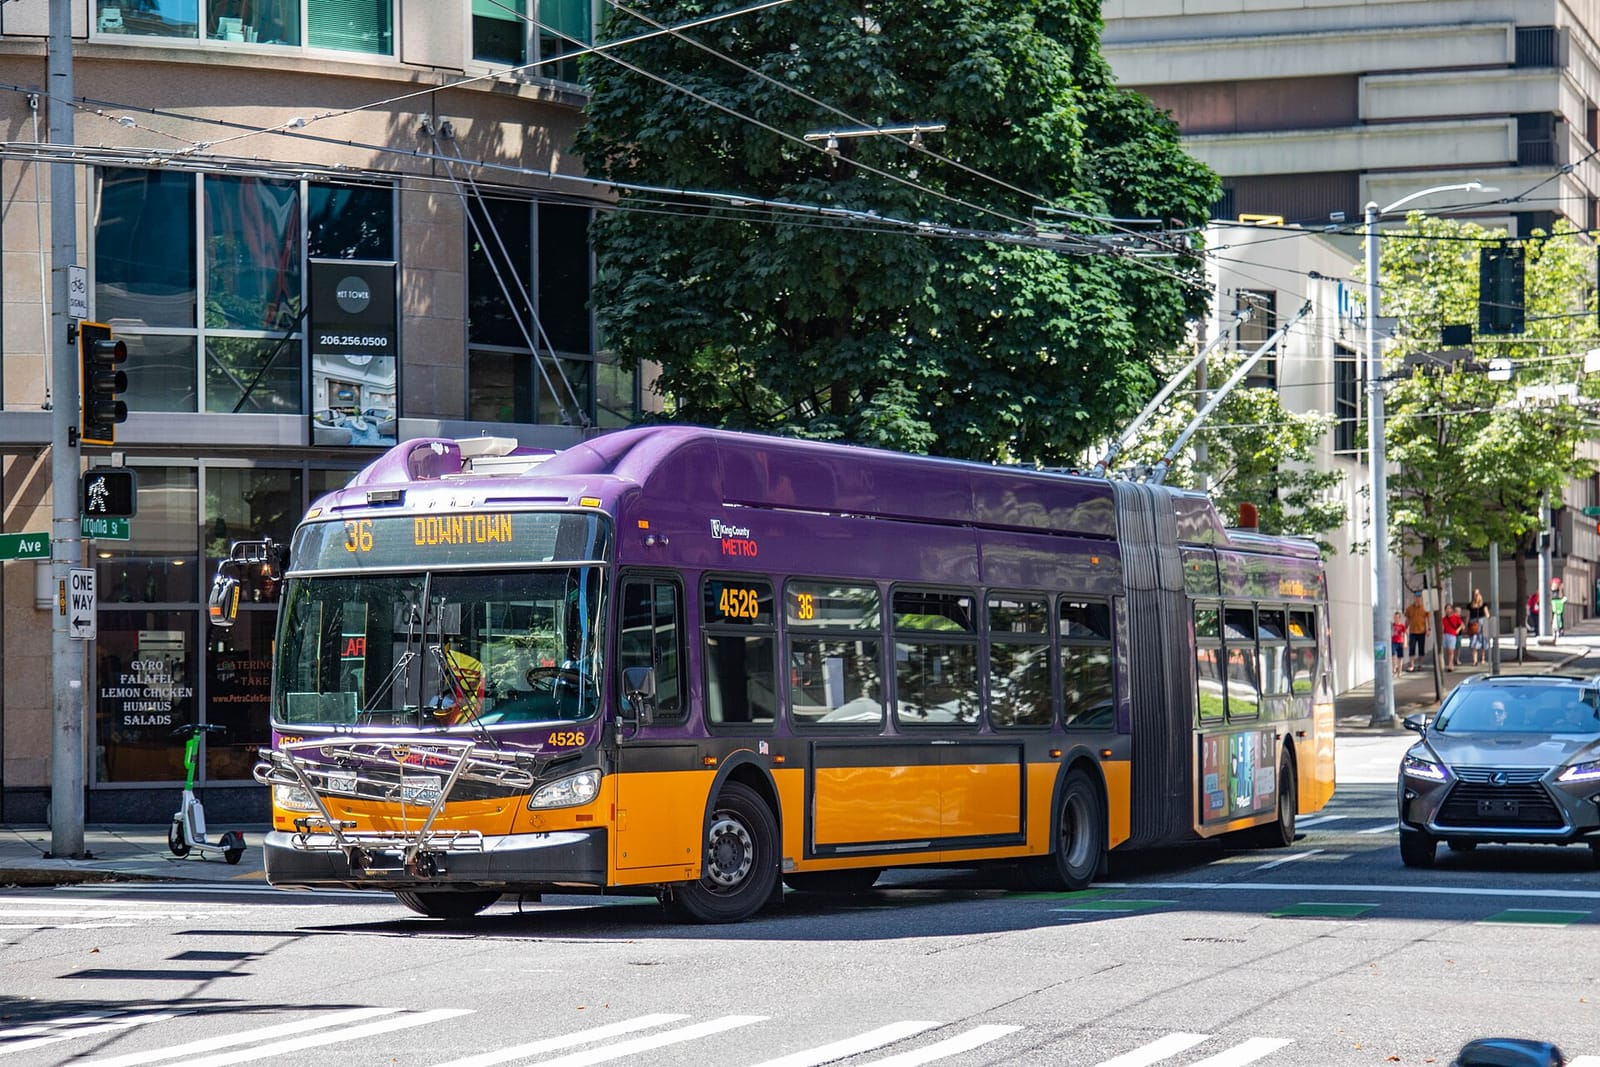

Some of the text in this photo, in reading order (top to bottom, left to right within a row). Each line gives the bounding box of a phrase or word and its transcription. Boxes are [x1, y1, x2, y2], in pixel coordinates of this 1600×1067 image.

[319, 335, 388, 347] 206.256.0500
[344, 513, 513, 552] 36 DOWNTOWN
[18, 539, 42, 553] Ave
[721, 538, 758, 557] METRO
[72, 574, 94, 591] ONE
[72, 594, 94, 610] WAY
[719, 588, 759, 618] 4526
[798, 593, 814, 619] 36
[131, 660, 164, 671] GYRO
[120, 674, 175, 684] FALAFEL
[240, 676, 270, 686] TAKE
[102, 687, 193, 698] LEMON CHICKEN
[123, 701, 172, 712] HUMMUS
[123, 715, 172, 725] SALADS
[548, 732, 585, 746] 4526
